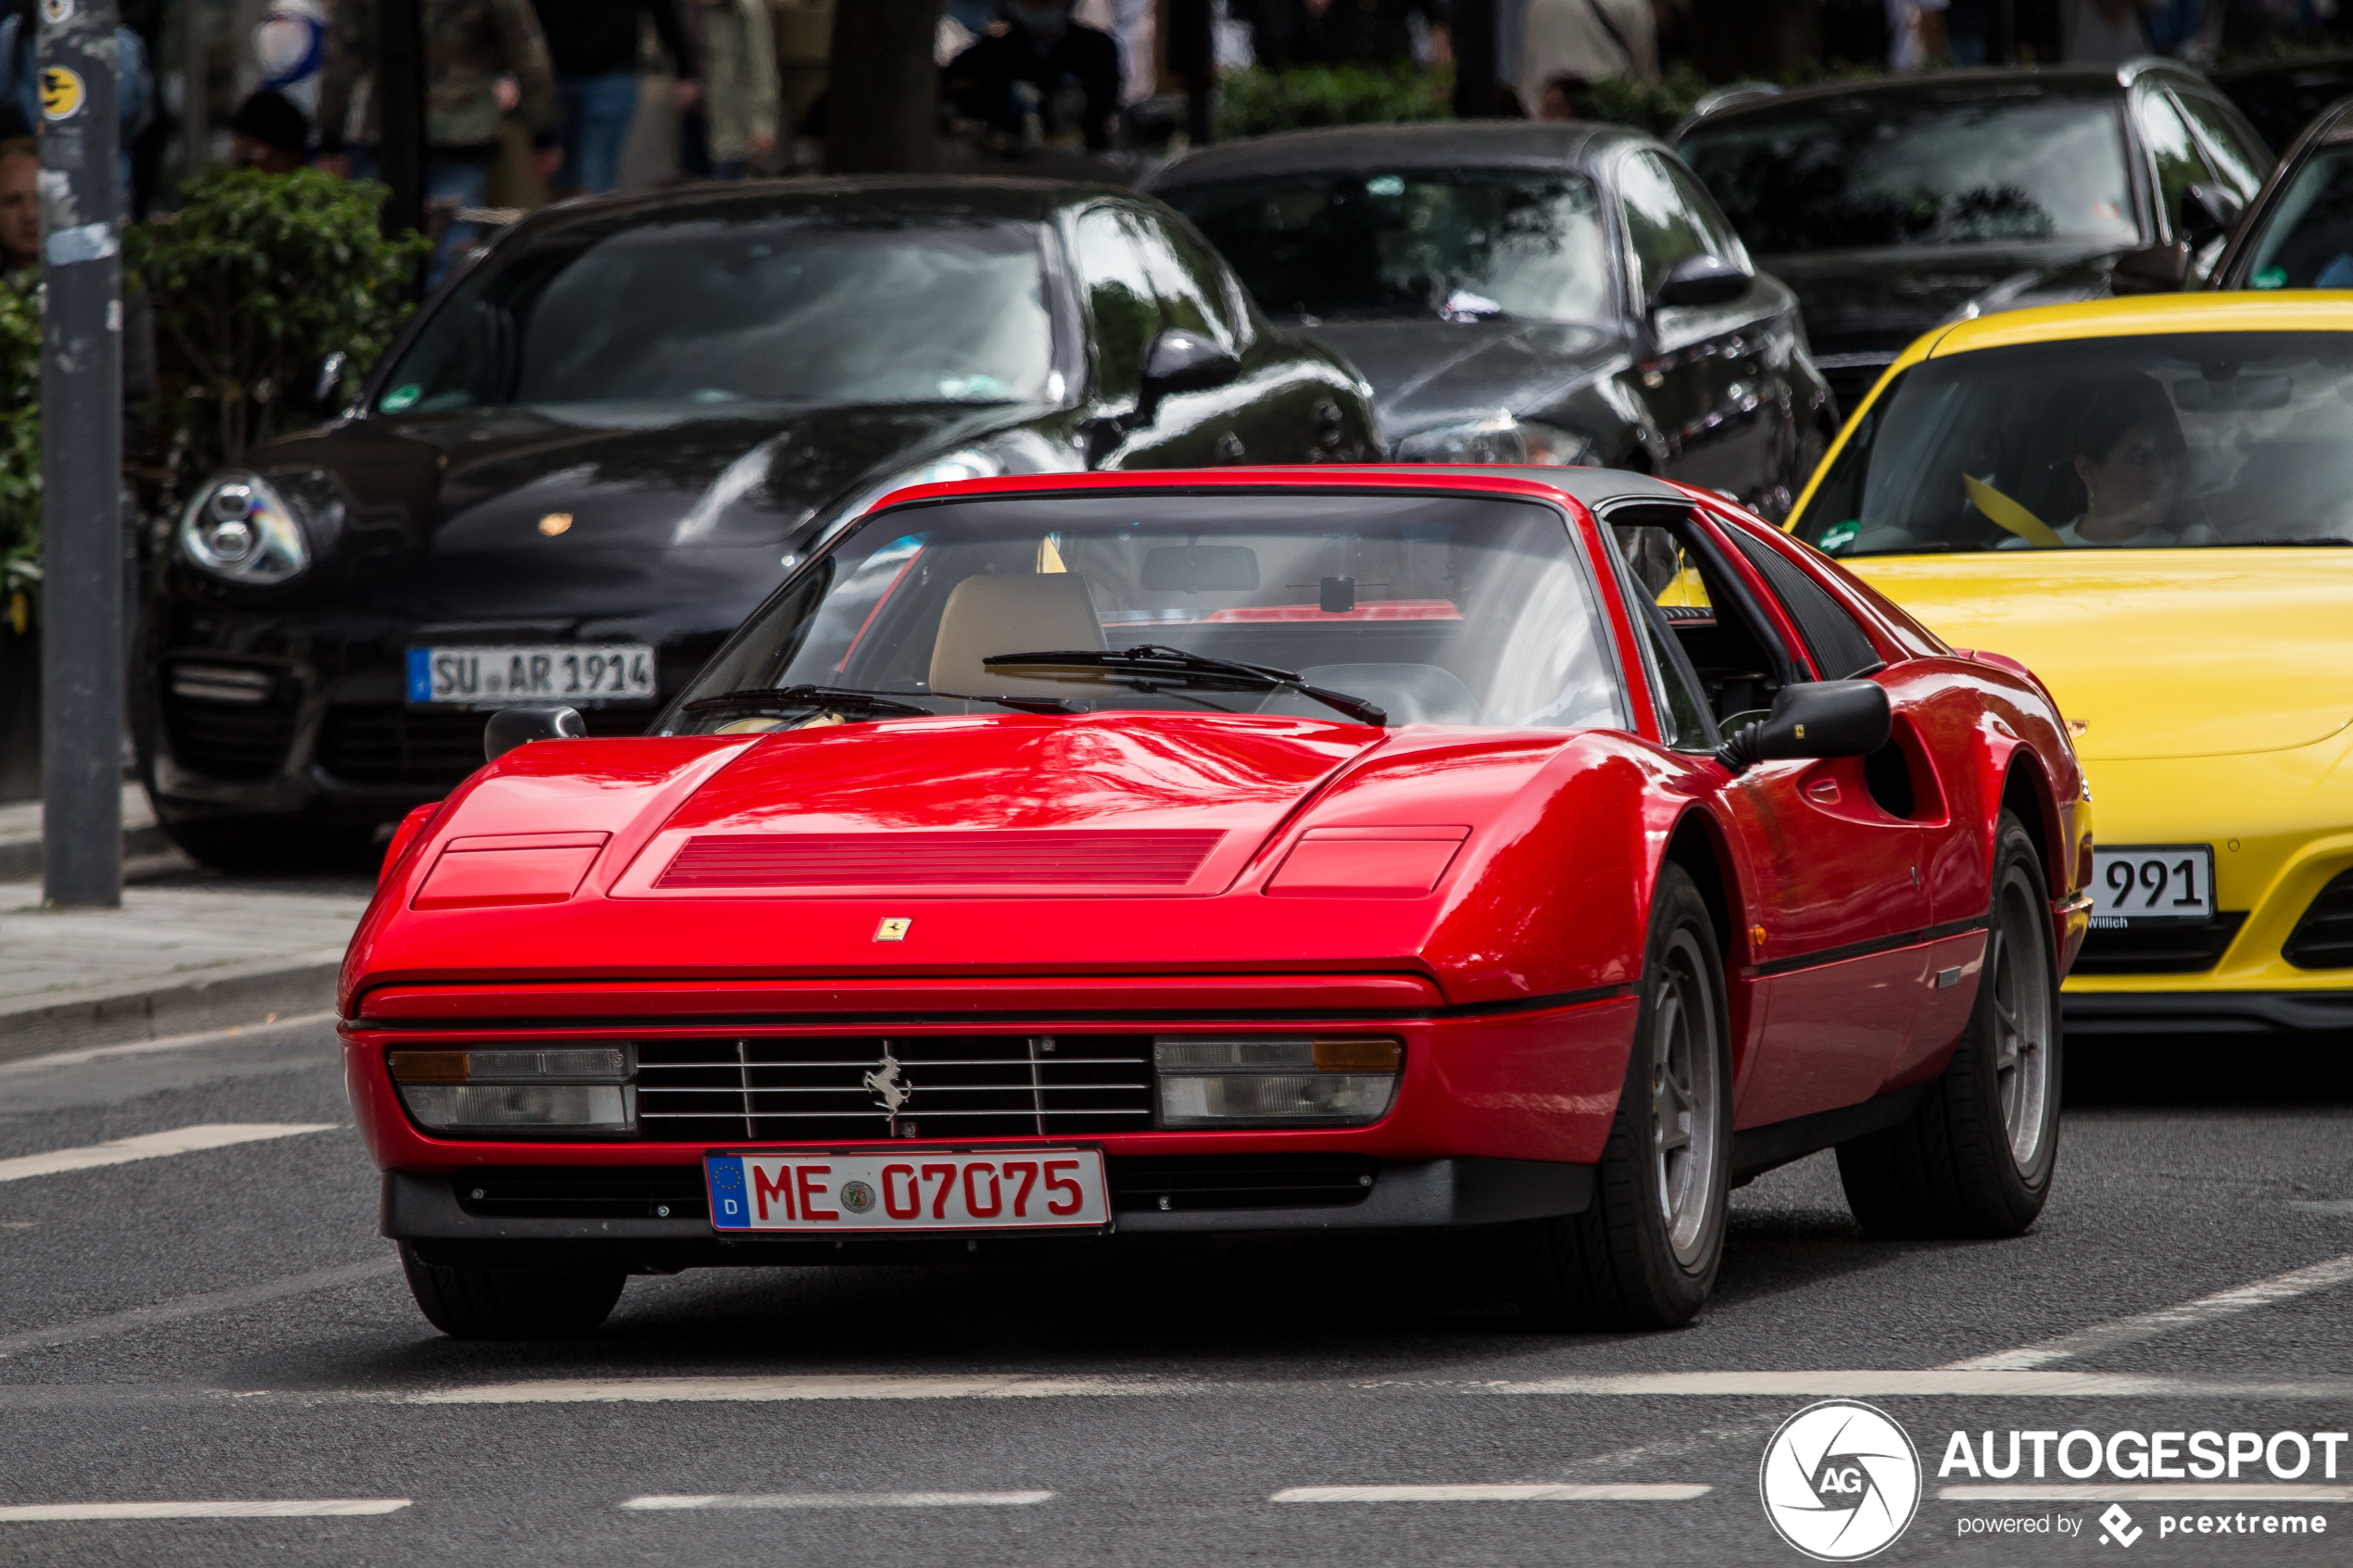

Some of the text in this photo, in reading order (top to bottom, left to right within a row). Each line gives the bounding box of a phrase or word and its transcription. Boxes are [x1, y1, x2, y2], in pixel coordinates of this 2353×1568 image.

[434, 654, 478, 694] SU
[510, 654, 553, 692] AR
[2107, 859, 2203, 908] 991
[724, 1199, 738, 1214] D
[753, 1160, 1083, 1221] ME 07075
